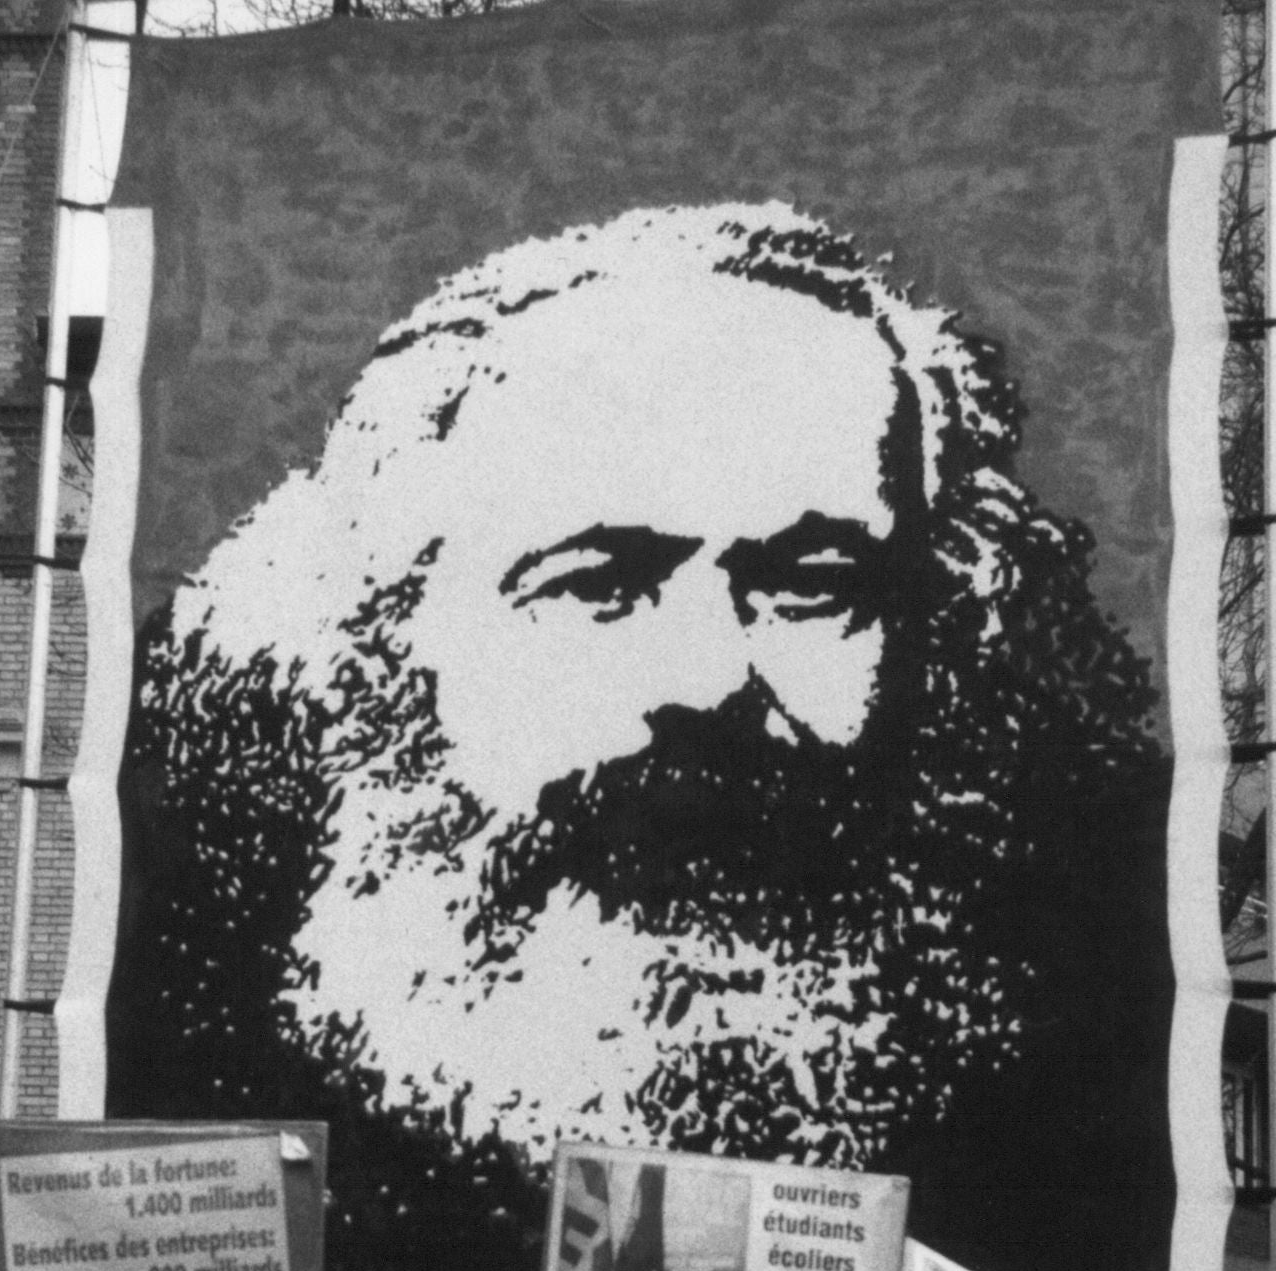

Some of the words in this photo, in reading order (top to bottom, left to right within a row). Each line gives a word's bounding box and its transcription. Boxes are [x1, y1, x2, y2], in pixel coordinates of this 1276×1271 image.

[7, 1169, 90, 1196] Revenus
[98, 1163, 124, 1190] de
[129, 1160, 149, 1187] la
[153, 1155, 237, 1185] fortune:
[124, 1193, 183, 1221] 1.400
[188, 1186, 278, 1214] milliards
[772, 1182, 862, 1210] ouvriers
[763, 1211, 865, 1243] étudiants
[12, 1237, 109, 1268] Bénéfices
[115, 1235, 151, 1260] des
[155, 1226, 276, 1262] entreprises:
